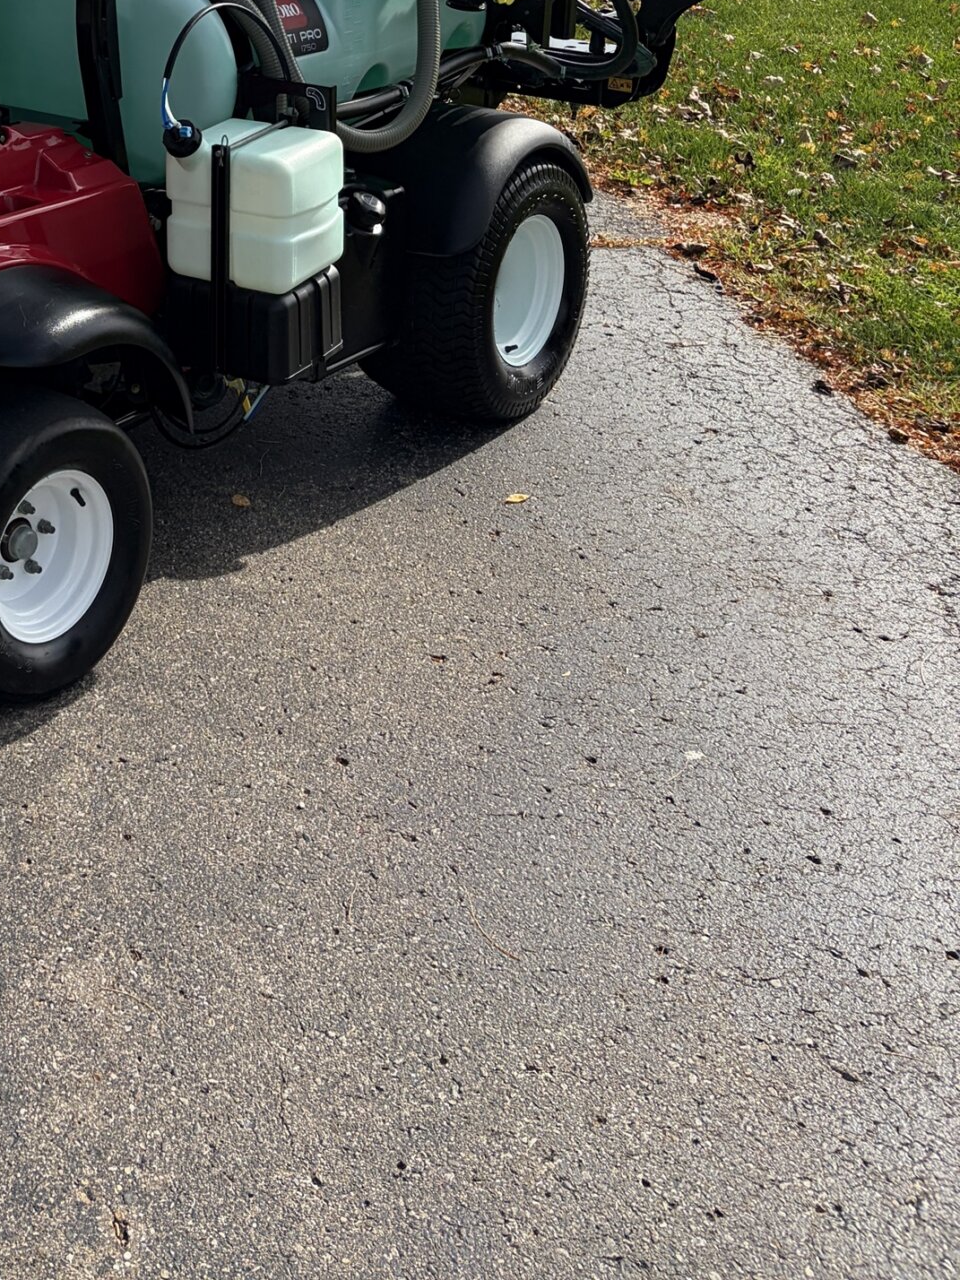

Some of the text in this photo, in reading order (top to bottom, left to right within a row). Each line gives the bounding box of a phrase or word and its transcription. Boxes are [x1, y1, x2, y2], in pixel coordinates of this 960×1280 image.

[277, 2, 300, 18] ORO
[299, 28, 322, 42] PRO
[301, 42, 317, 52] 1750
